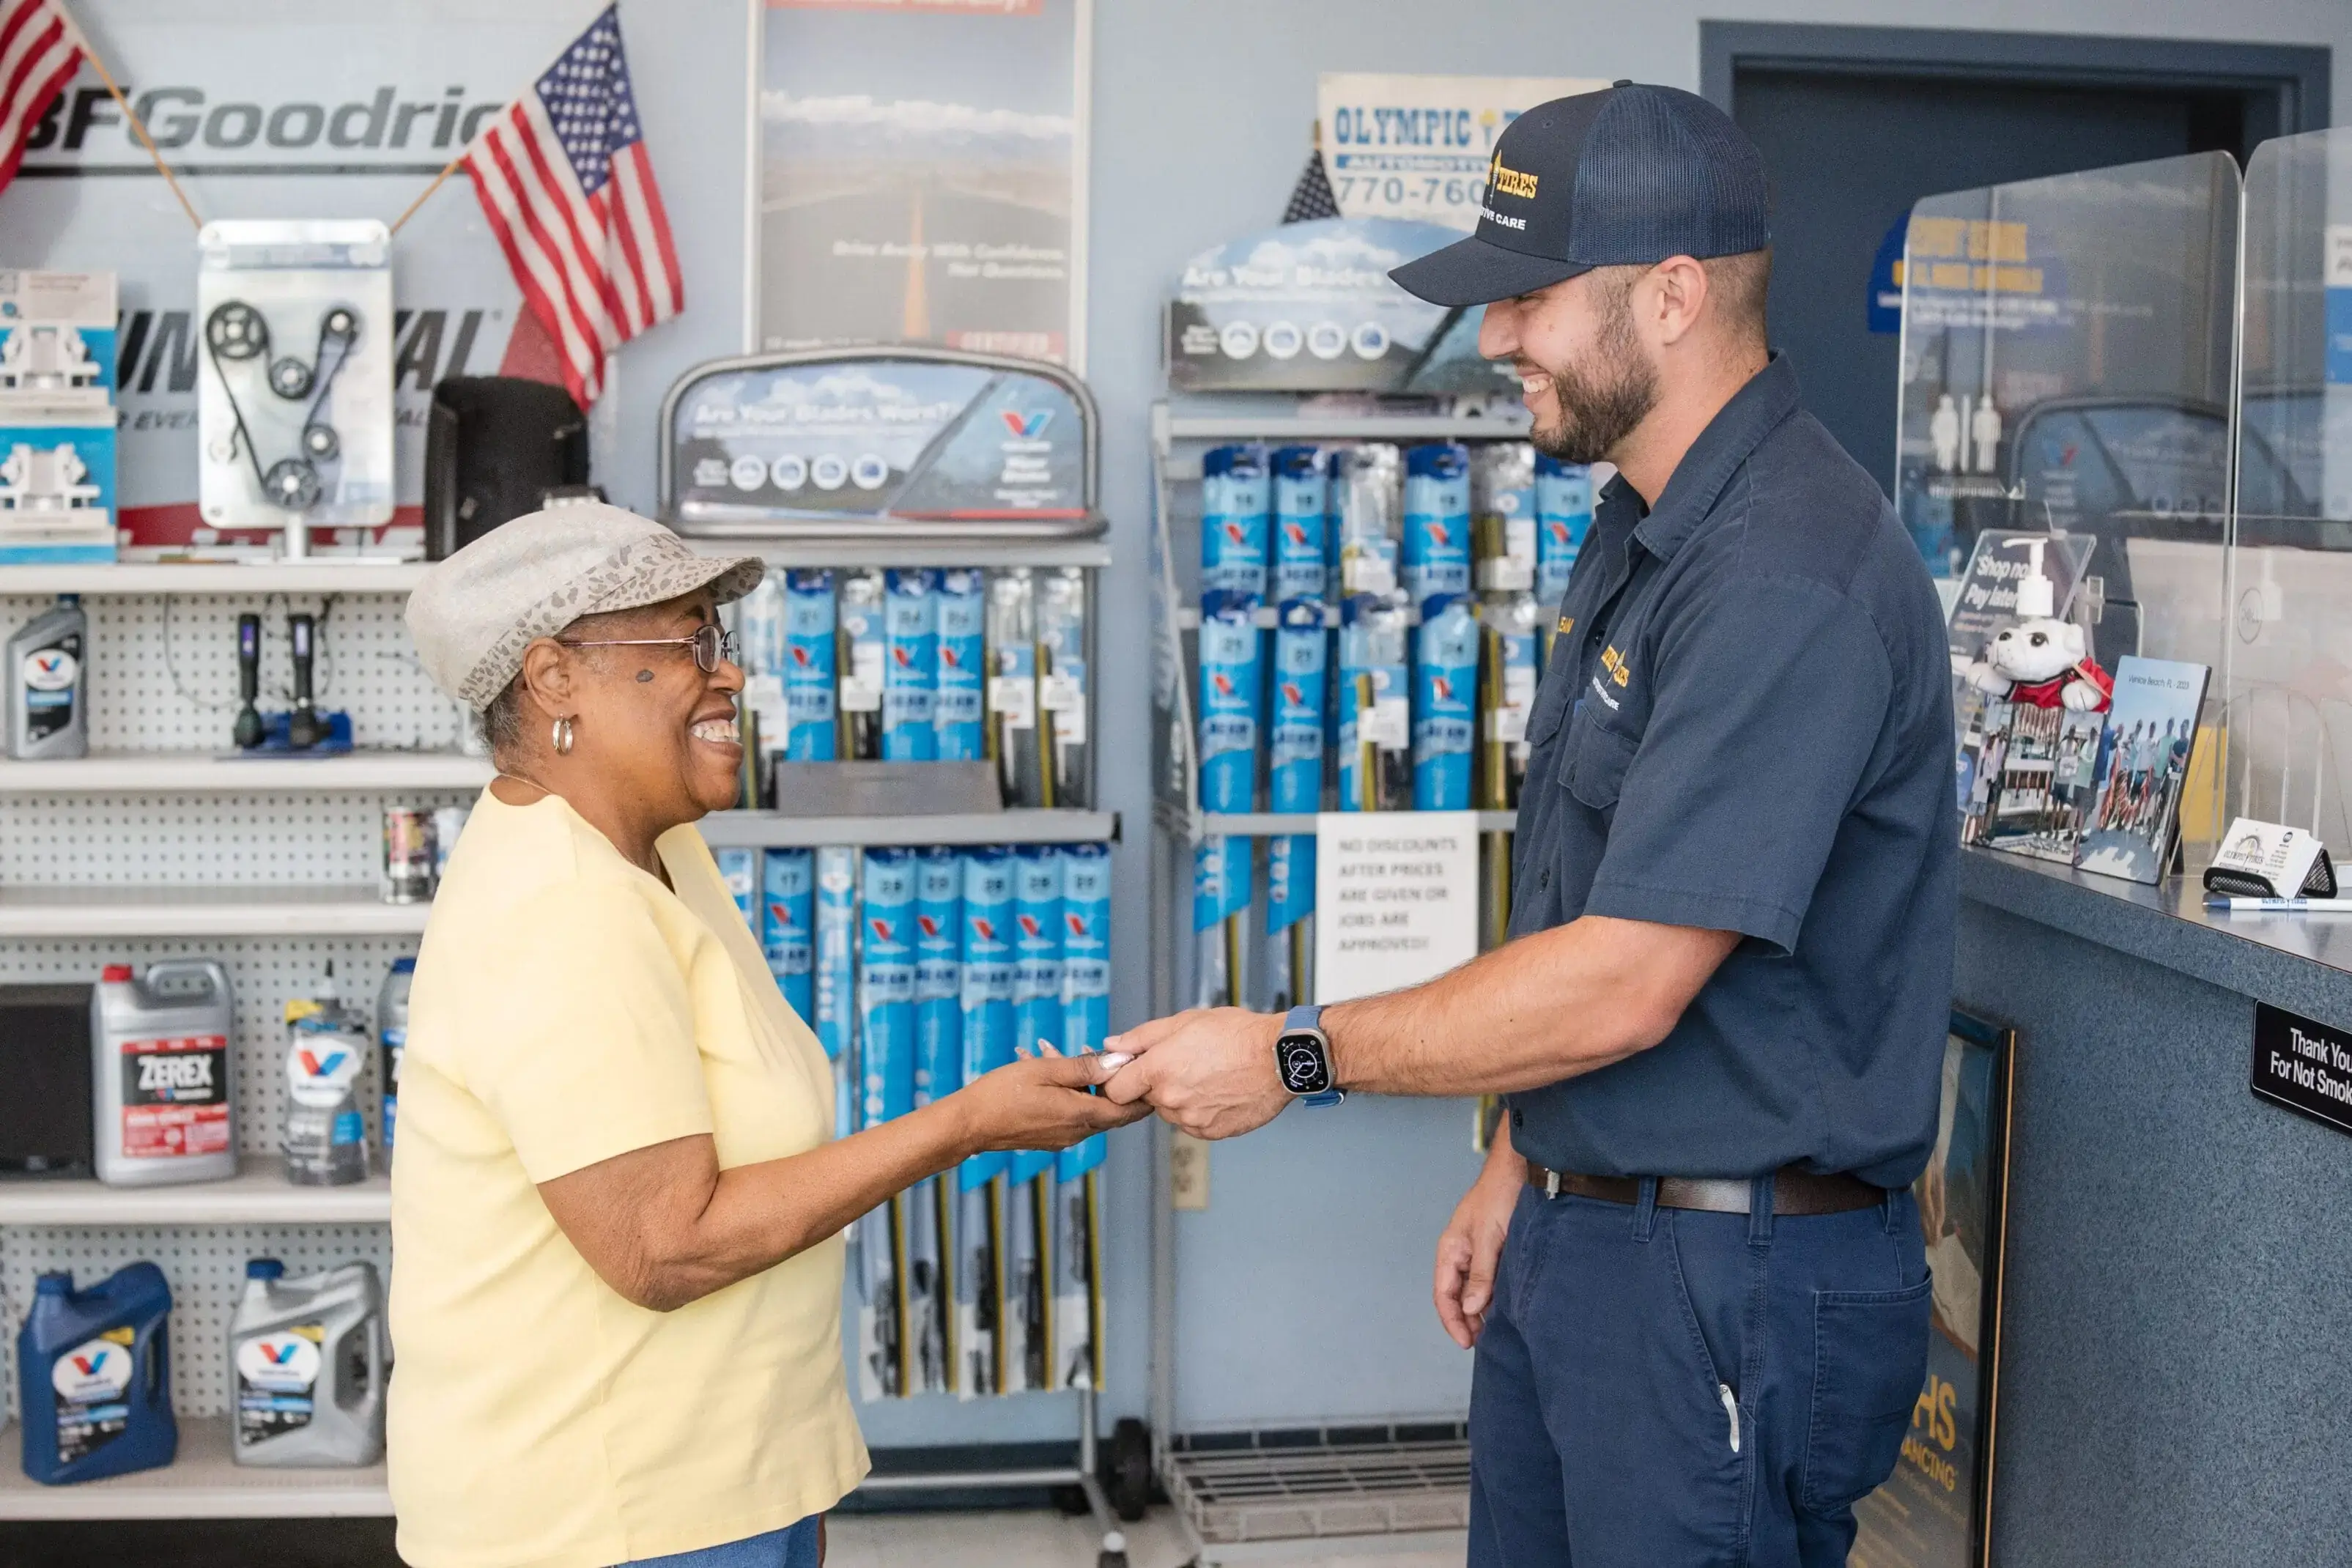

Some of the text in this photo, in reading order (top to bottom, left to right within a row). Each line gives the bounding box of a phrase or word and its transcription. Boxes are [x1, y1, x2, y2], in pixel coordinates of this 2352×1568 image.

[1335, 107, 1471, 146] OLYMPIC
[1496, 166, 1538, 199] TIRES
[1495, 213, 1527, 231] CARE
[1977, 554, 2011, 583] Shop
[1964, 583, 1991, 610] Pay
[2129, 674, 2147, 684] Venice
[1339, 837, 1457, 852] NO DISCOUNTS
[2223, 850, 2246, 862] OLYMPIC
[2248, 856, 2265, 865] TIRES
[1339, 862, 1443, 877] AFTER PRICES
[1339, 885, 1448, 901] ARE GIVEN OR
[1339, 911, 1409, 927] JOBS ARE
[2290, 1027, 2352, 1073] Thank You
[138, 1054, 214, 1090] ZEREX
[2271, 1050, 2291, 1079] For
[2293, 1060, 2315, 1090] Not
